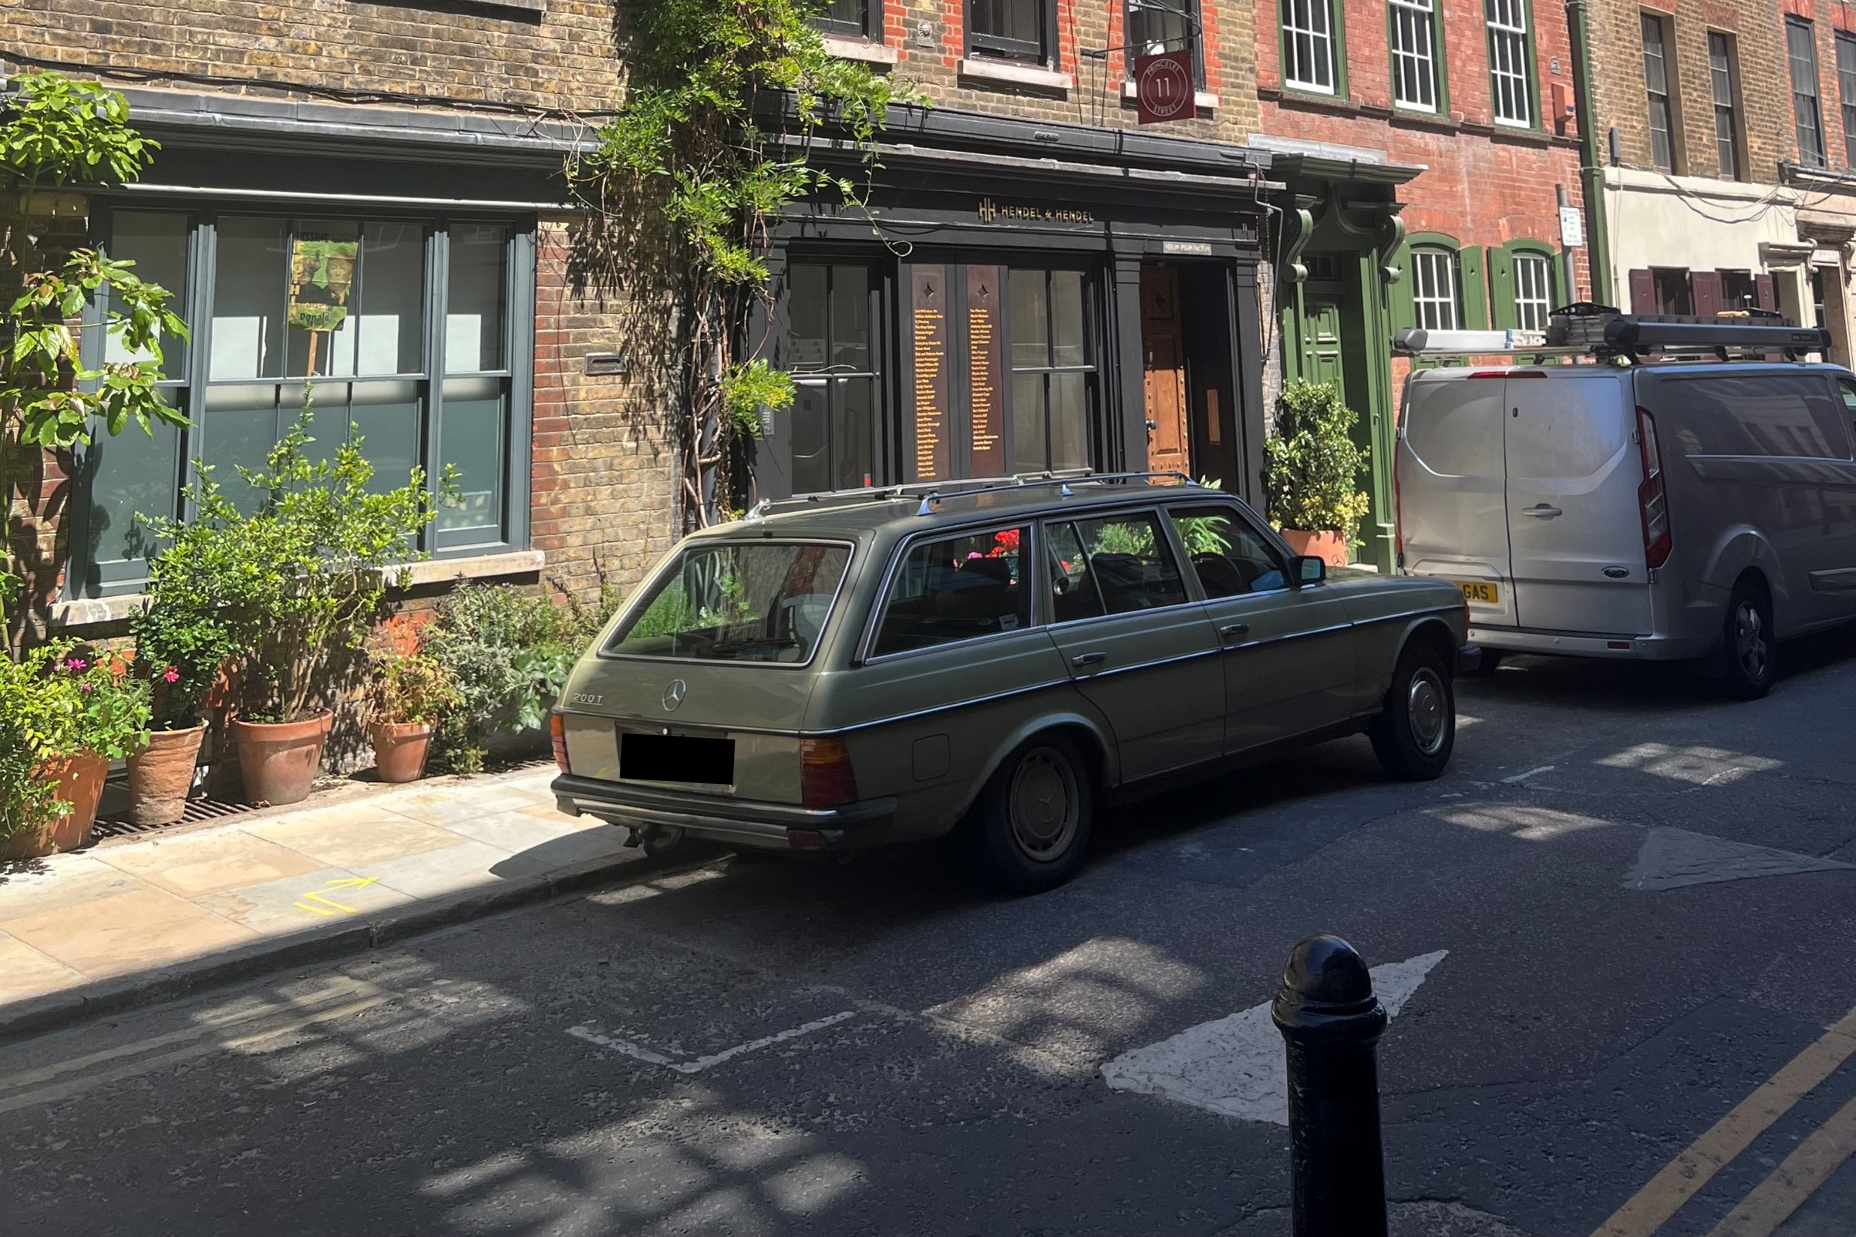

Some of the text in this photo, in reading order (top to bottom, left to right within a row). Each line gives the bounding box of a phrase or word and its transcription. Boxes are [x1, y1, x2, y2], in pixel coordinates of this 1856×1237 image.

[1147, 60, 1180, 75] PRINCELET
[1156, 77, 1170, 98] 11
[1153, 103, 1177, 114] STREET
[1001, 205, 1094, 221] HENDEL & HENDEL
[1462, 584, 1489, 600] GAS
